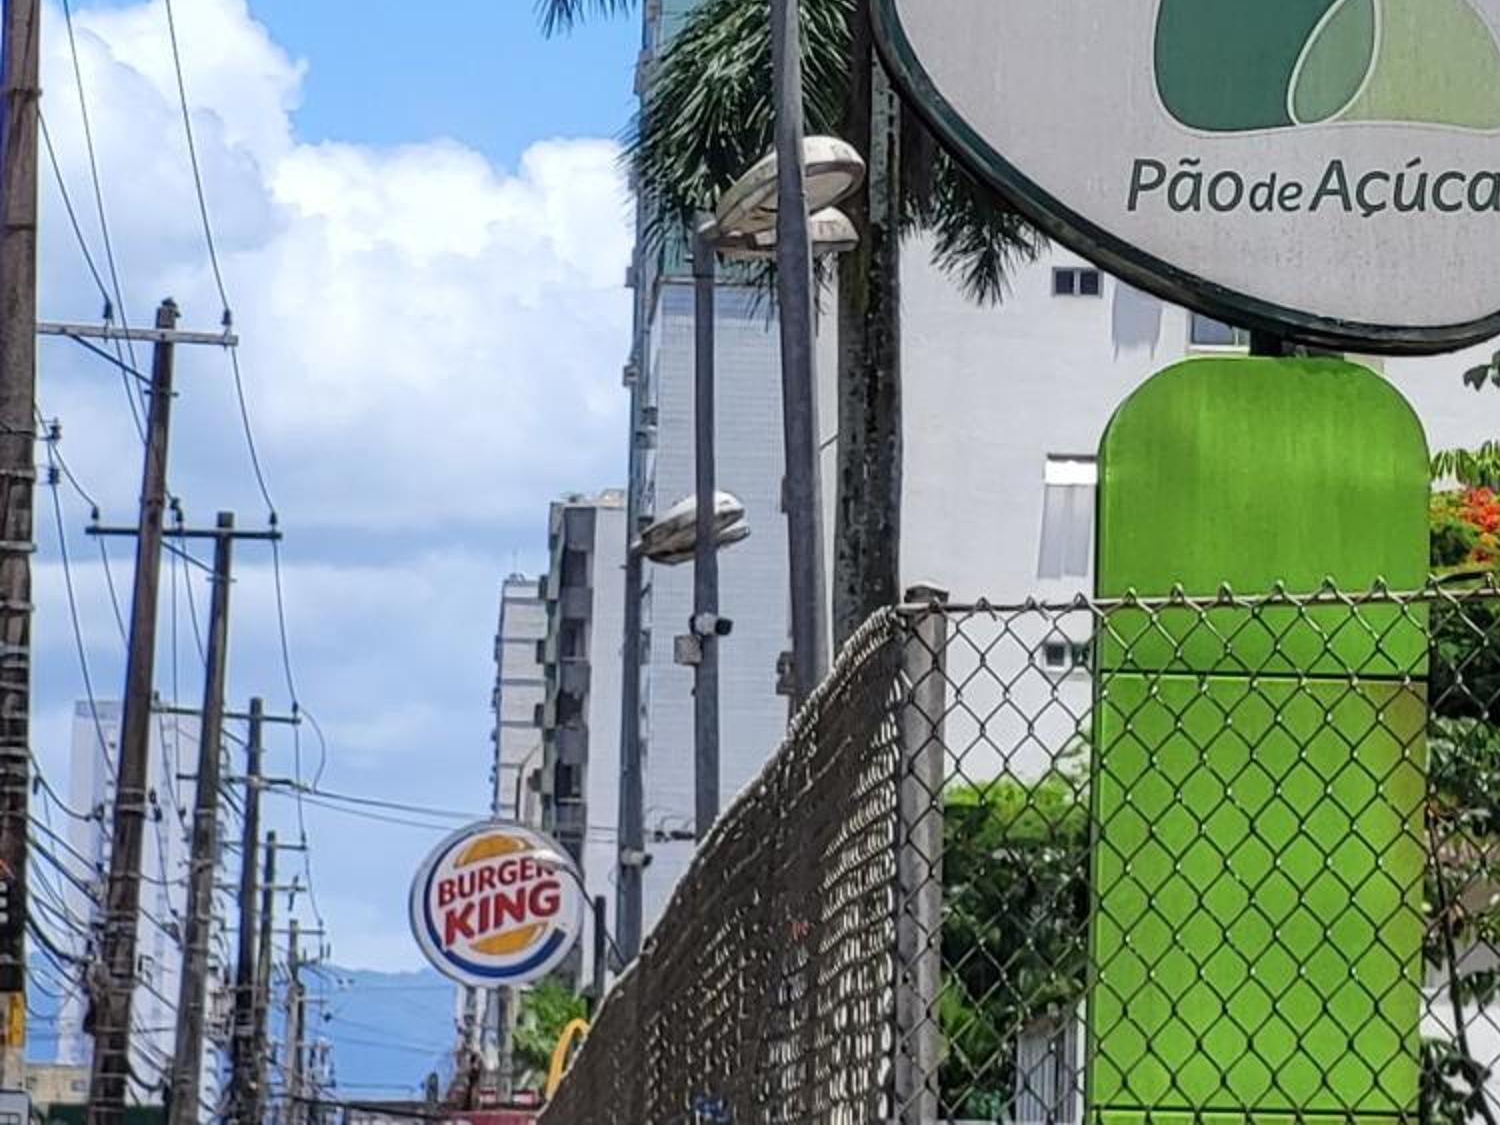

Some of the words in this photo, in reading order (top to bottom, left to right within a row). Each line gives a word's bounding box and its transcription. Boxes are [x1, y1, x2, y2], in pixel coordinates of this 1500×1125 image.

[1127, 157, 1245, 213] Pão
[1248, 172, 1303, 213] de
[444, 880, 562, 947] KING
